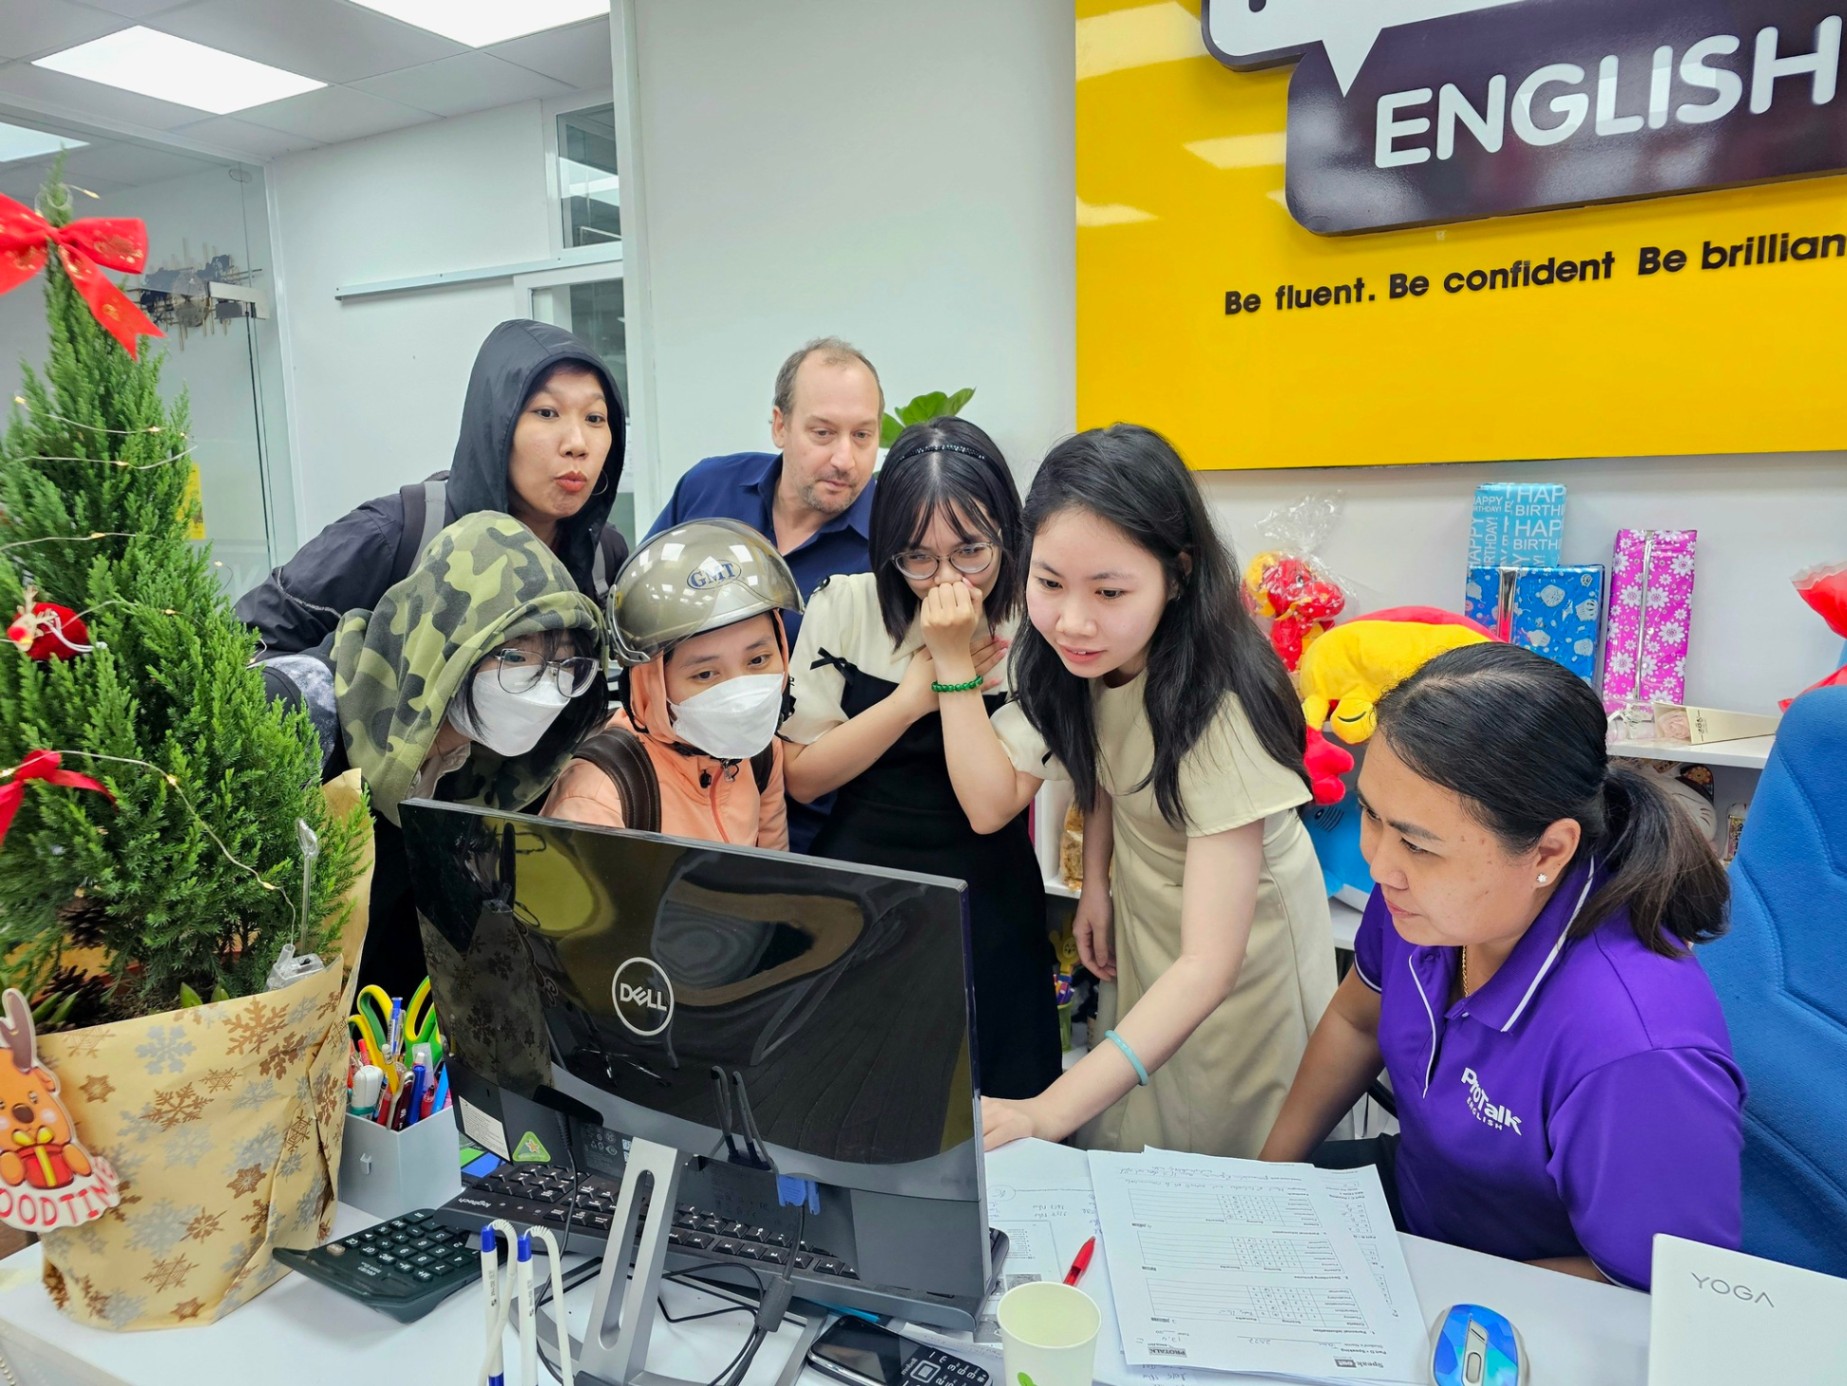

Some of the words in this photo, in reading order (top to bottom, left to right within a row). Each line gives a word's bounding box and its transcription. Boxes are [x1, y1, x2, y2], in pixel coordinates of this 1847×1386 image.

[1375, 15, 1842, 169] ENGLISH
[1225, 291, 1262, 315] Be
[1275, 277, 1376, 311] fluent.
[1389, 273, 1430, 299] Be
[1443, 251, 1615, 294] confident
[1638, 246, 1687, 276] Be
[1515, 504, 1564, 516] BIRTH
[1513, 538, 1560, 550] BIRTH
[620, 982, 667, 1012] DELL
[1466, 1096, 1503, 1131] ENGLISH
[1691, 1272, 1774, 1308] YOGA
